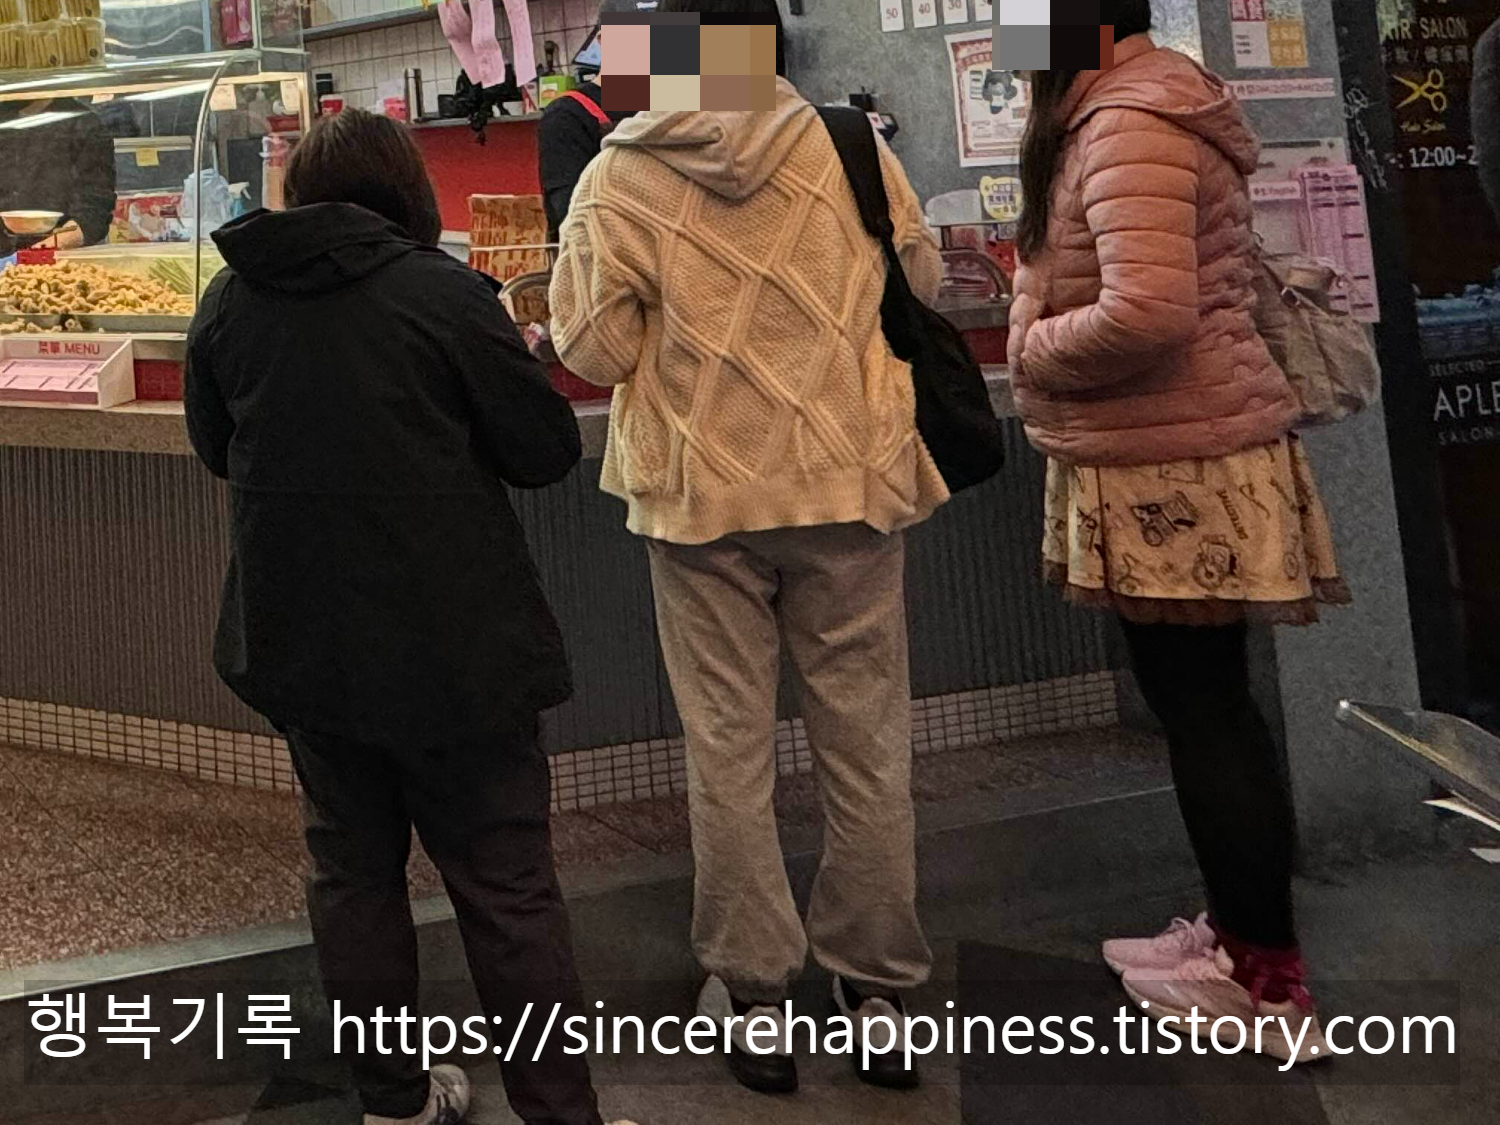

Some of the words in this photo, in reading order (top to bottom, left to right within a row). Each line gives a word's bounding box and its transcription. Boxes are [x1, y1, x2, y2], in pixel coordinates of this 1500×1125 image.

[918, 3, 931, 15] 40
[1419, 17, 1469, 40] SALON
[38, 341, 61, 355] 菜單
[64, 342, 101, 356] MENU
